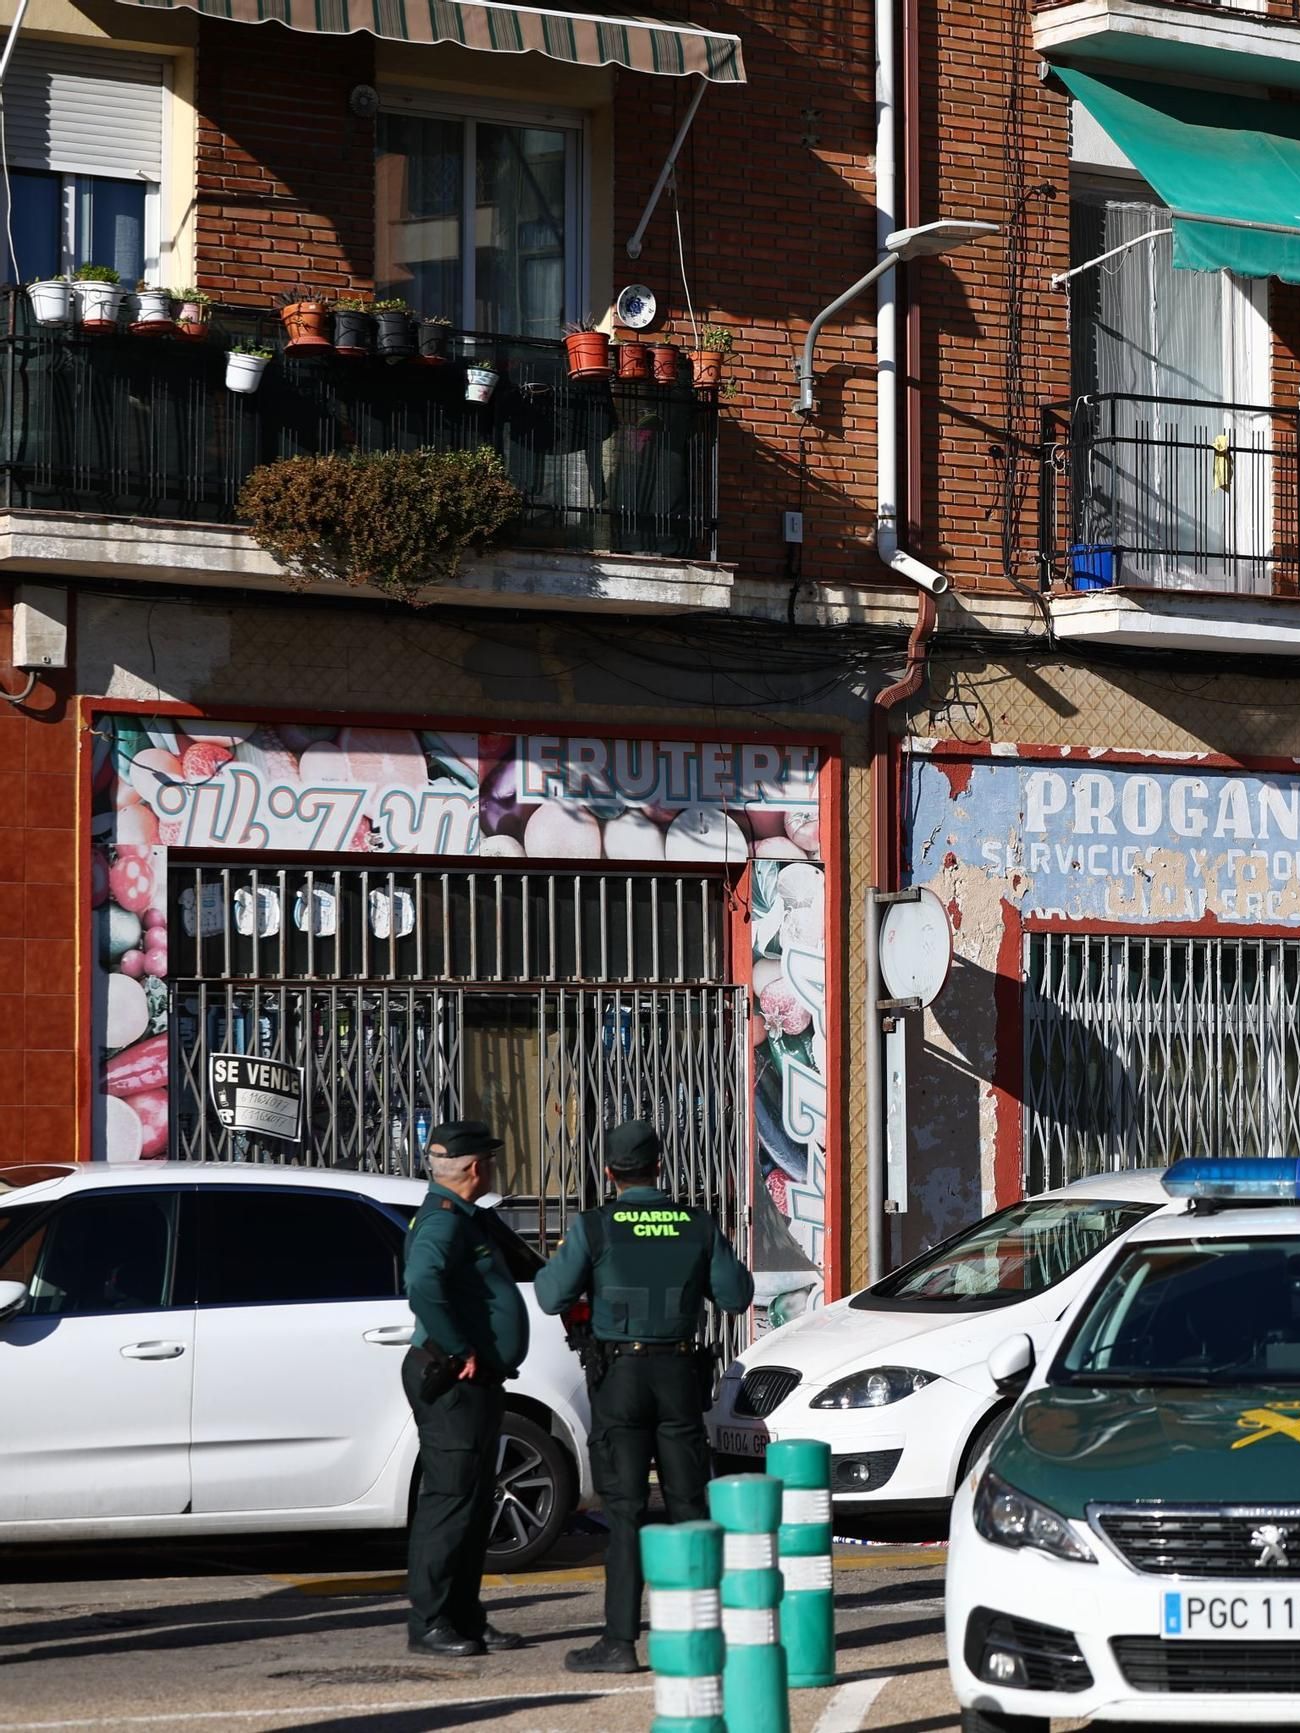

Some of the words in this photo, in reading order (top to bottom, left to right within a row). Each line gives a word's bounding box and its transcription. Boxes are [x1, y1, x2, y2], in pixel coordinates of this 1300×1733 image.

[524, 736, 818, 800] FRUTERI
[214, 1060, 240, 1083] SE
[247, 1063, 300, 1095] VENDE
[613, 1211, 691, 1222] GUARDIA
[633, 1224, 680, 1237] CIVIL
[722, 1431, 748, 1453] 0104
[1186, 1597, 1249, 1629] PGC
